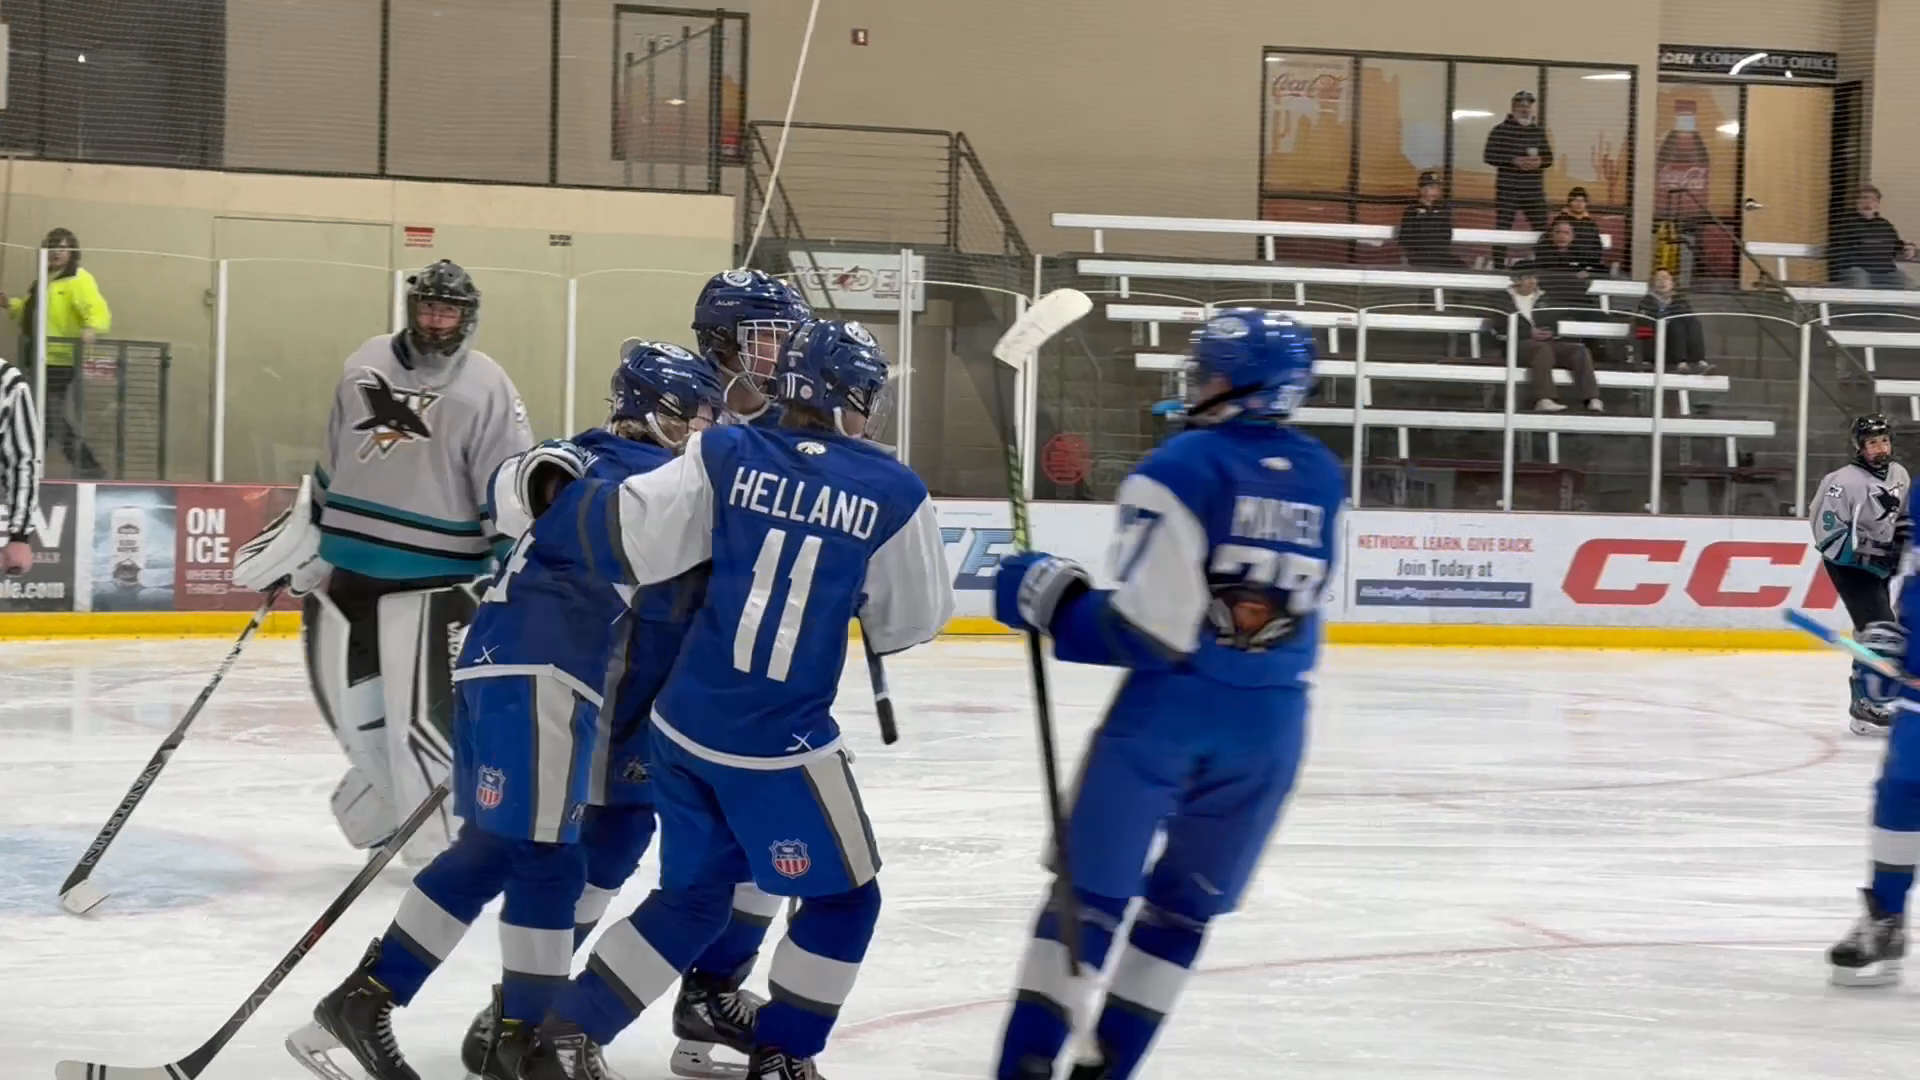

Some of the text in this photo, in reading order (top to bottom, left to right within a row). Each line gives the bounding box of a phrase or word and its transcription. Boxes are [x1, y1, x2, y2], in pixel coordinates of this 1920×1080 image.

[729, 466, 879, 540] HELLAND
[185, 507, 226, 535] ON
[185, 536, 231, 563] ICE
[1358, 534, 1419, 549] NETWORK.
[1467, 537, 1494, 552] GIVE
[1397, 558, 1494, 579] Join Today at
[1562, 538, 1840, 610] CC
[733, 528, 823, 682] 11
